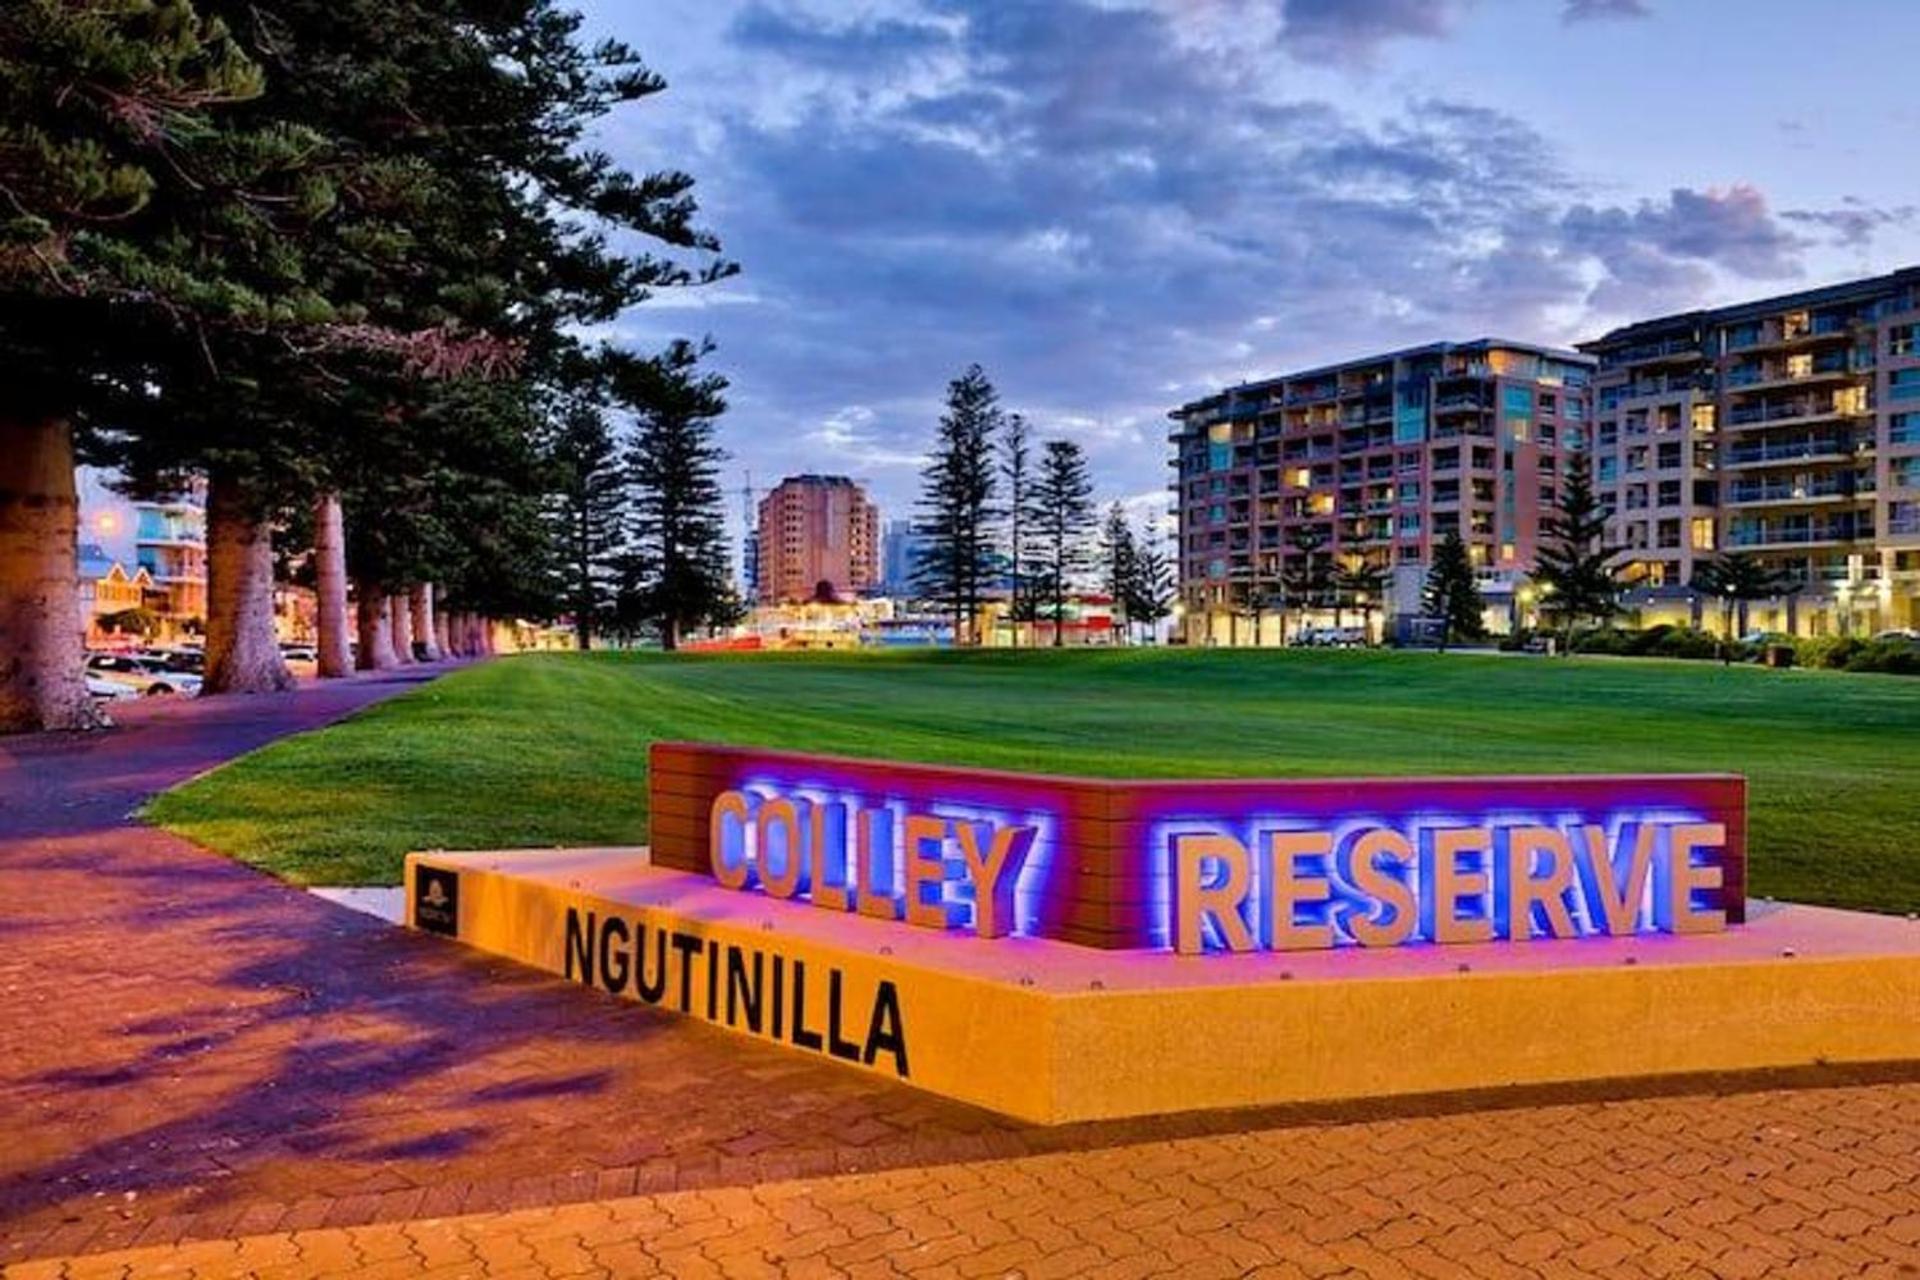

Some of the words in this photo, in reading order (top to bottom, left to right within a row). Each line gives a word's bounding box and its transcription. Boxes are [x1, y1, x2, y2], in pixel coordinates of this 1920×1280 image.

[710, 790, 1018, 939] COLLEY
[1176, 823, 1726, 954] RESERVE
[565, 908, 910, 1077] NGUTINILLA
